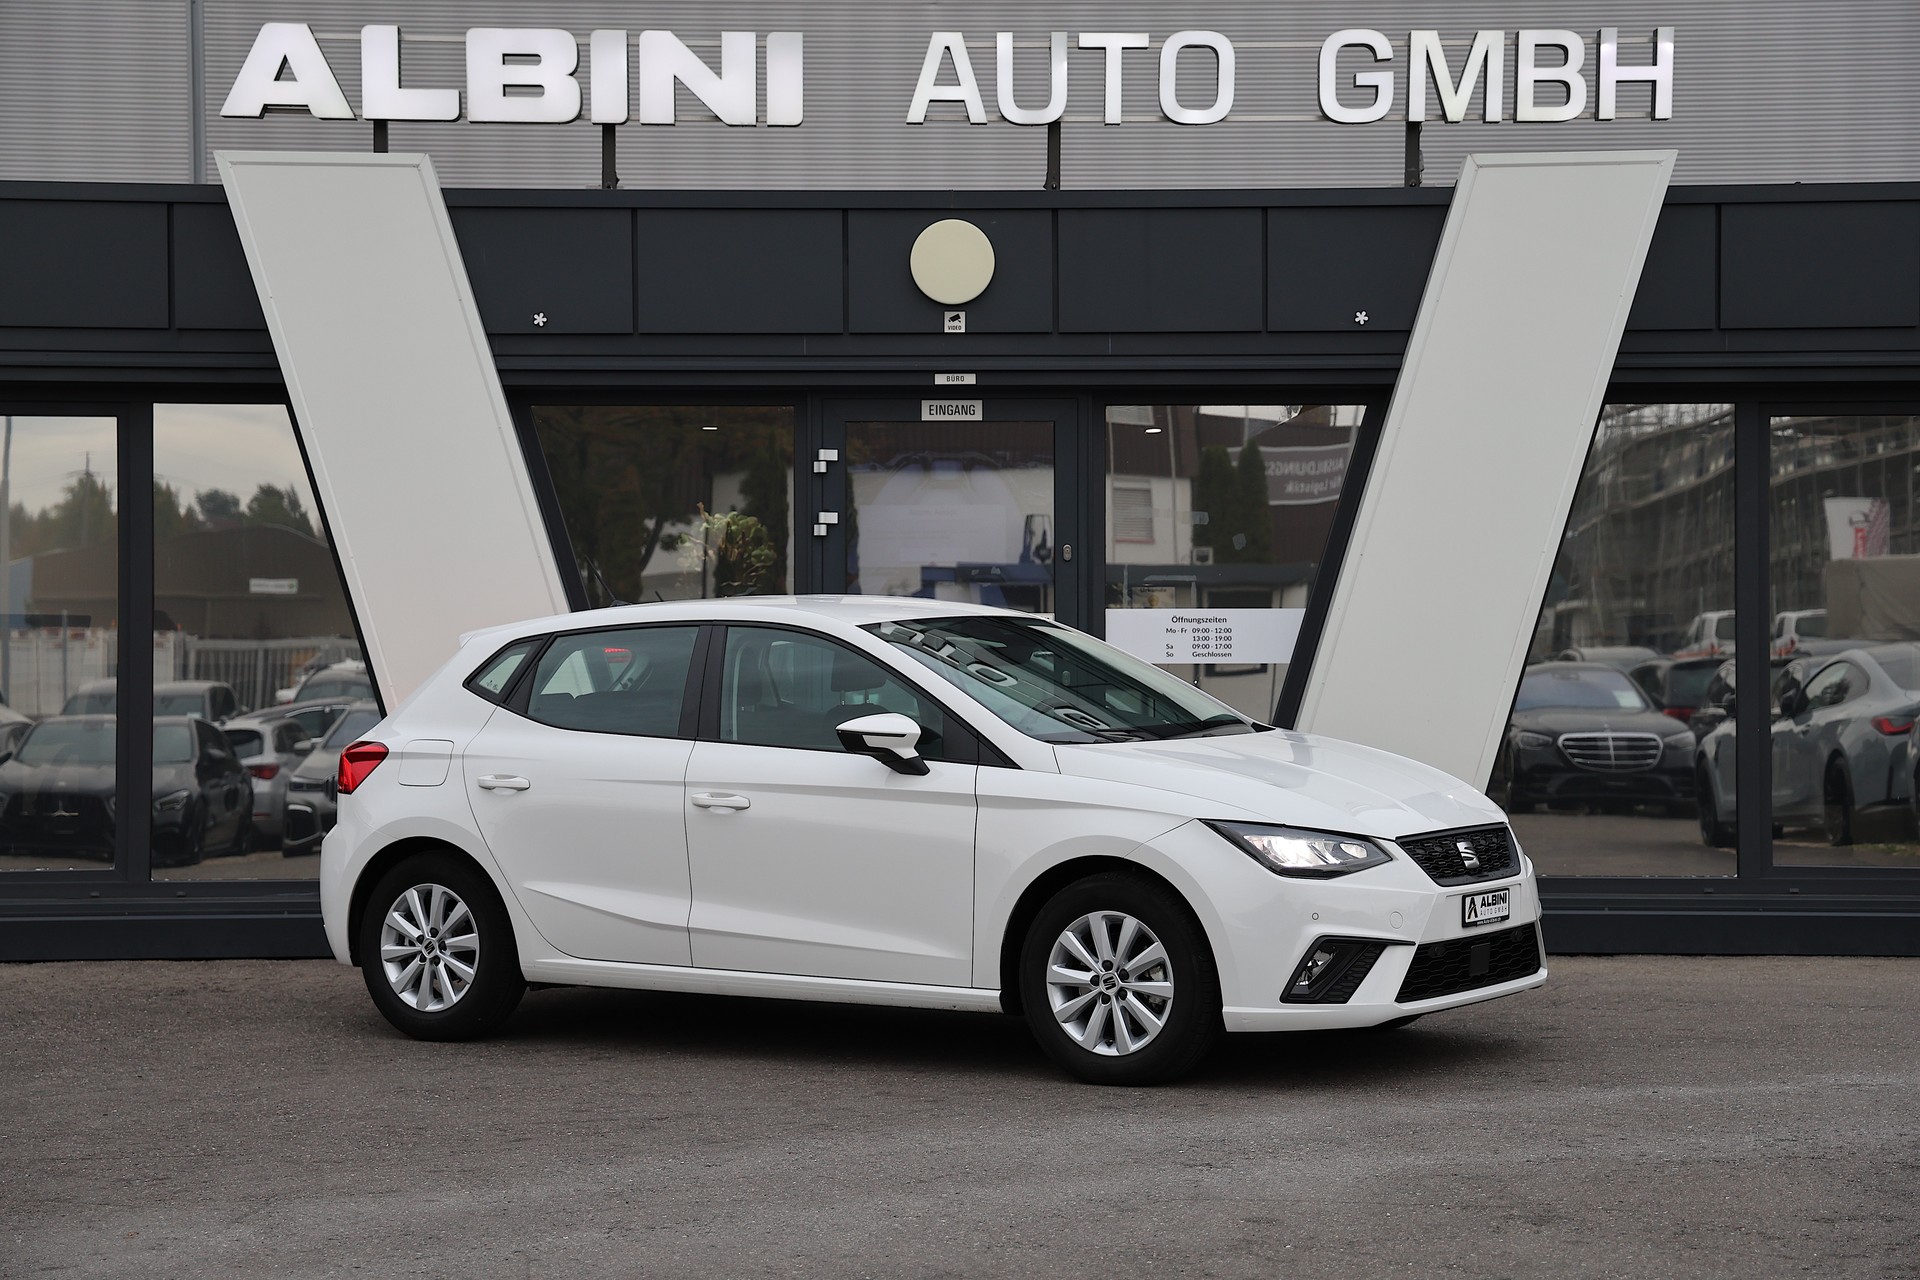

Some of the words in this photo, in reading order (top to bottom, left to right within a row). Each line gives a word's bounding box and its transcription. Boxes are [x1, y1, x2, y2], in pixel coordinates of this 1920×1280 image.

[219, 22, 804, 127] ALBINI
[906, 30, 1236, 126] AUTO
[1319, 26, 1676, 126] GMBH
[928, 404, 976, 416] EINGANG
[1171, 615, 1227, 624] Öffnungszeiten
[1480, 892, 1507, 908] ALBINI
